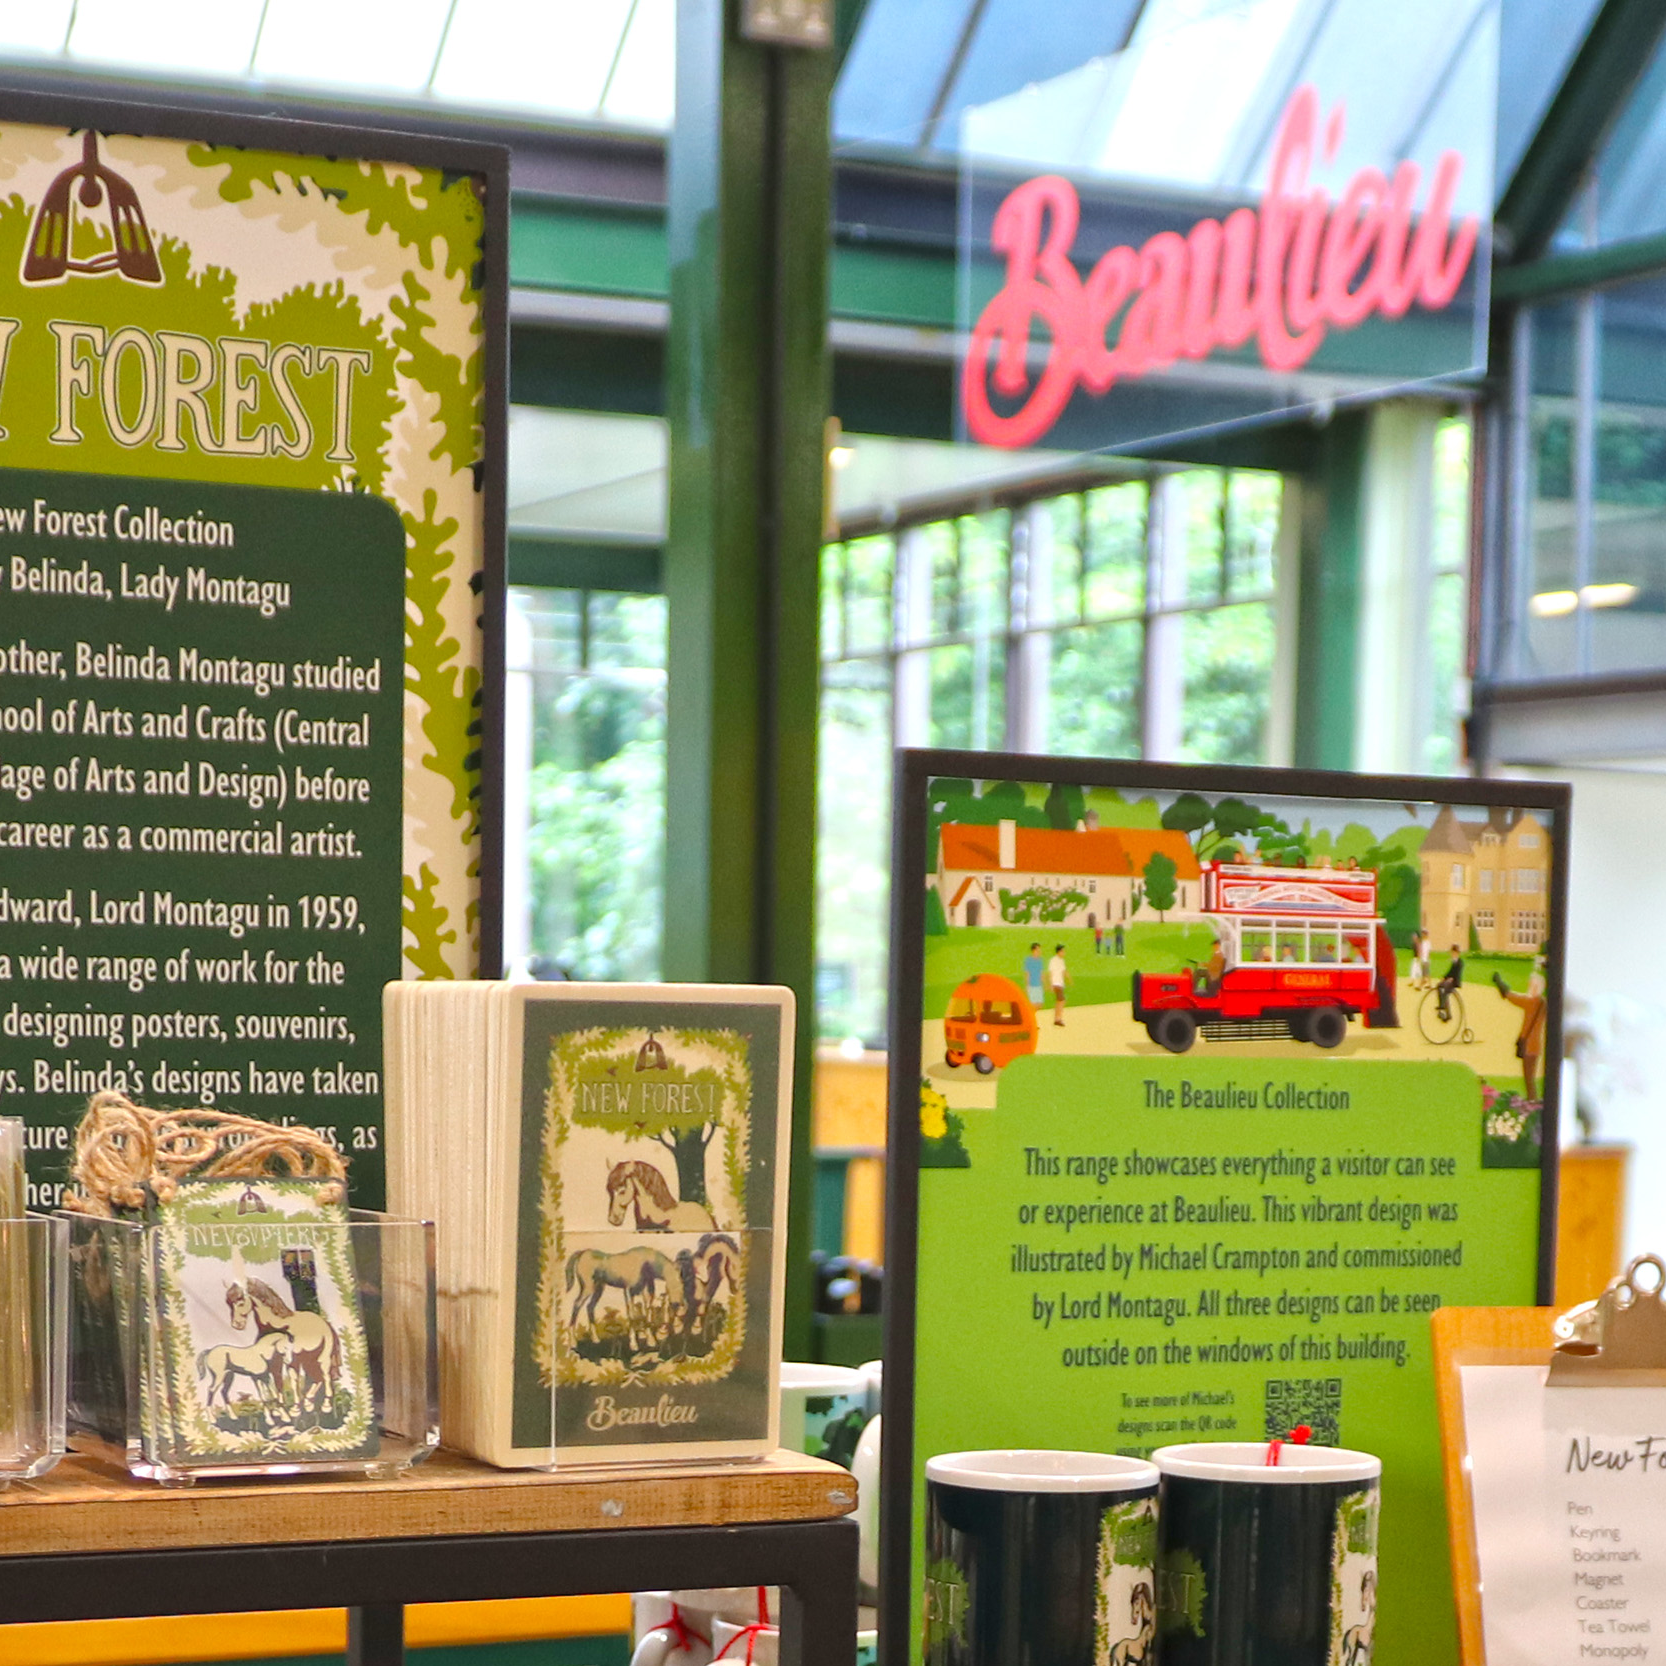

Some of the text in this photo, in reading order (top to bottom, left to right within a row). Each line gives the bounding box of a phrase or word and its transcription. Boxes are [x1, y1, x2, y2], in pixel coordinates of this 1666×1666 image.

[964, 82, 1479, 449] Beaulieu
[47, 320, 371, 462] FOREST
[34, 499, 108, 539] Forest
[114, 504, 234, 547] Collection
[11, 556, 113, 601] Belinda,
[121, 562, 180, 611] Lady
[187, 566, 290, 617] Montagu
[76, 642, 172, 682] Belinda
[179, 647, 285, 697] Montagu
[292, 656, 380, 692] studied
[53, 756, 80, 791] of
[84, 757, 136, 794] Arts
[143, 761, 190, 796] and
[198, 762, 287, 810] Design)
[295, 766, 370, 803] before
[90, 889, 145, 925] Lord
[153, 891, 260, 939] Montagu
[267, 894, 290, 929] in
[298, 895, 366, 935] 1959,
[34, 1059, 144, 1099] Belinda's
[151, 1060, 242, 1105] designs
[249, 1060, 305, 1096] have
[311, 1061, 380, 1096] taken
[581, 1081, 715, 1114] NEW FOREST
[1143, 1079, 1350, 1111] The Beaulieu Collection
[1023, 1147, 1456, 1186] This range showcases everything a visitor can see
[1018, 1195, 1458, 1233] or experience at Beaulieu. This vibrant design was
[1011, 1240, 1462, 1280] illustrated by Michael Crampton and commissioned
[1032, 1289, 1440, 1330] by Lord Montagu. All three designs can be seen
[1062, 1334, 1410, 1368] outside on the windows of this building.
[587, 1394, 698, 1431] Beaulieu
[1566, 1437, 1634, 1473] New
[1567, 1502, 1593, 1515] Pen
[1570, 1526, 1620, 1541] Keyring
[1573, 1549, 1641, 1562] Bookmark
[1574, 1573, 1623, 1589] Magnet
[1576, 1597, 1628, 1609] Coaster
[1578, 1620, 1650, 1632] Tea Towel
[1580, 1644, 1648, 1659] Monopoly
